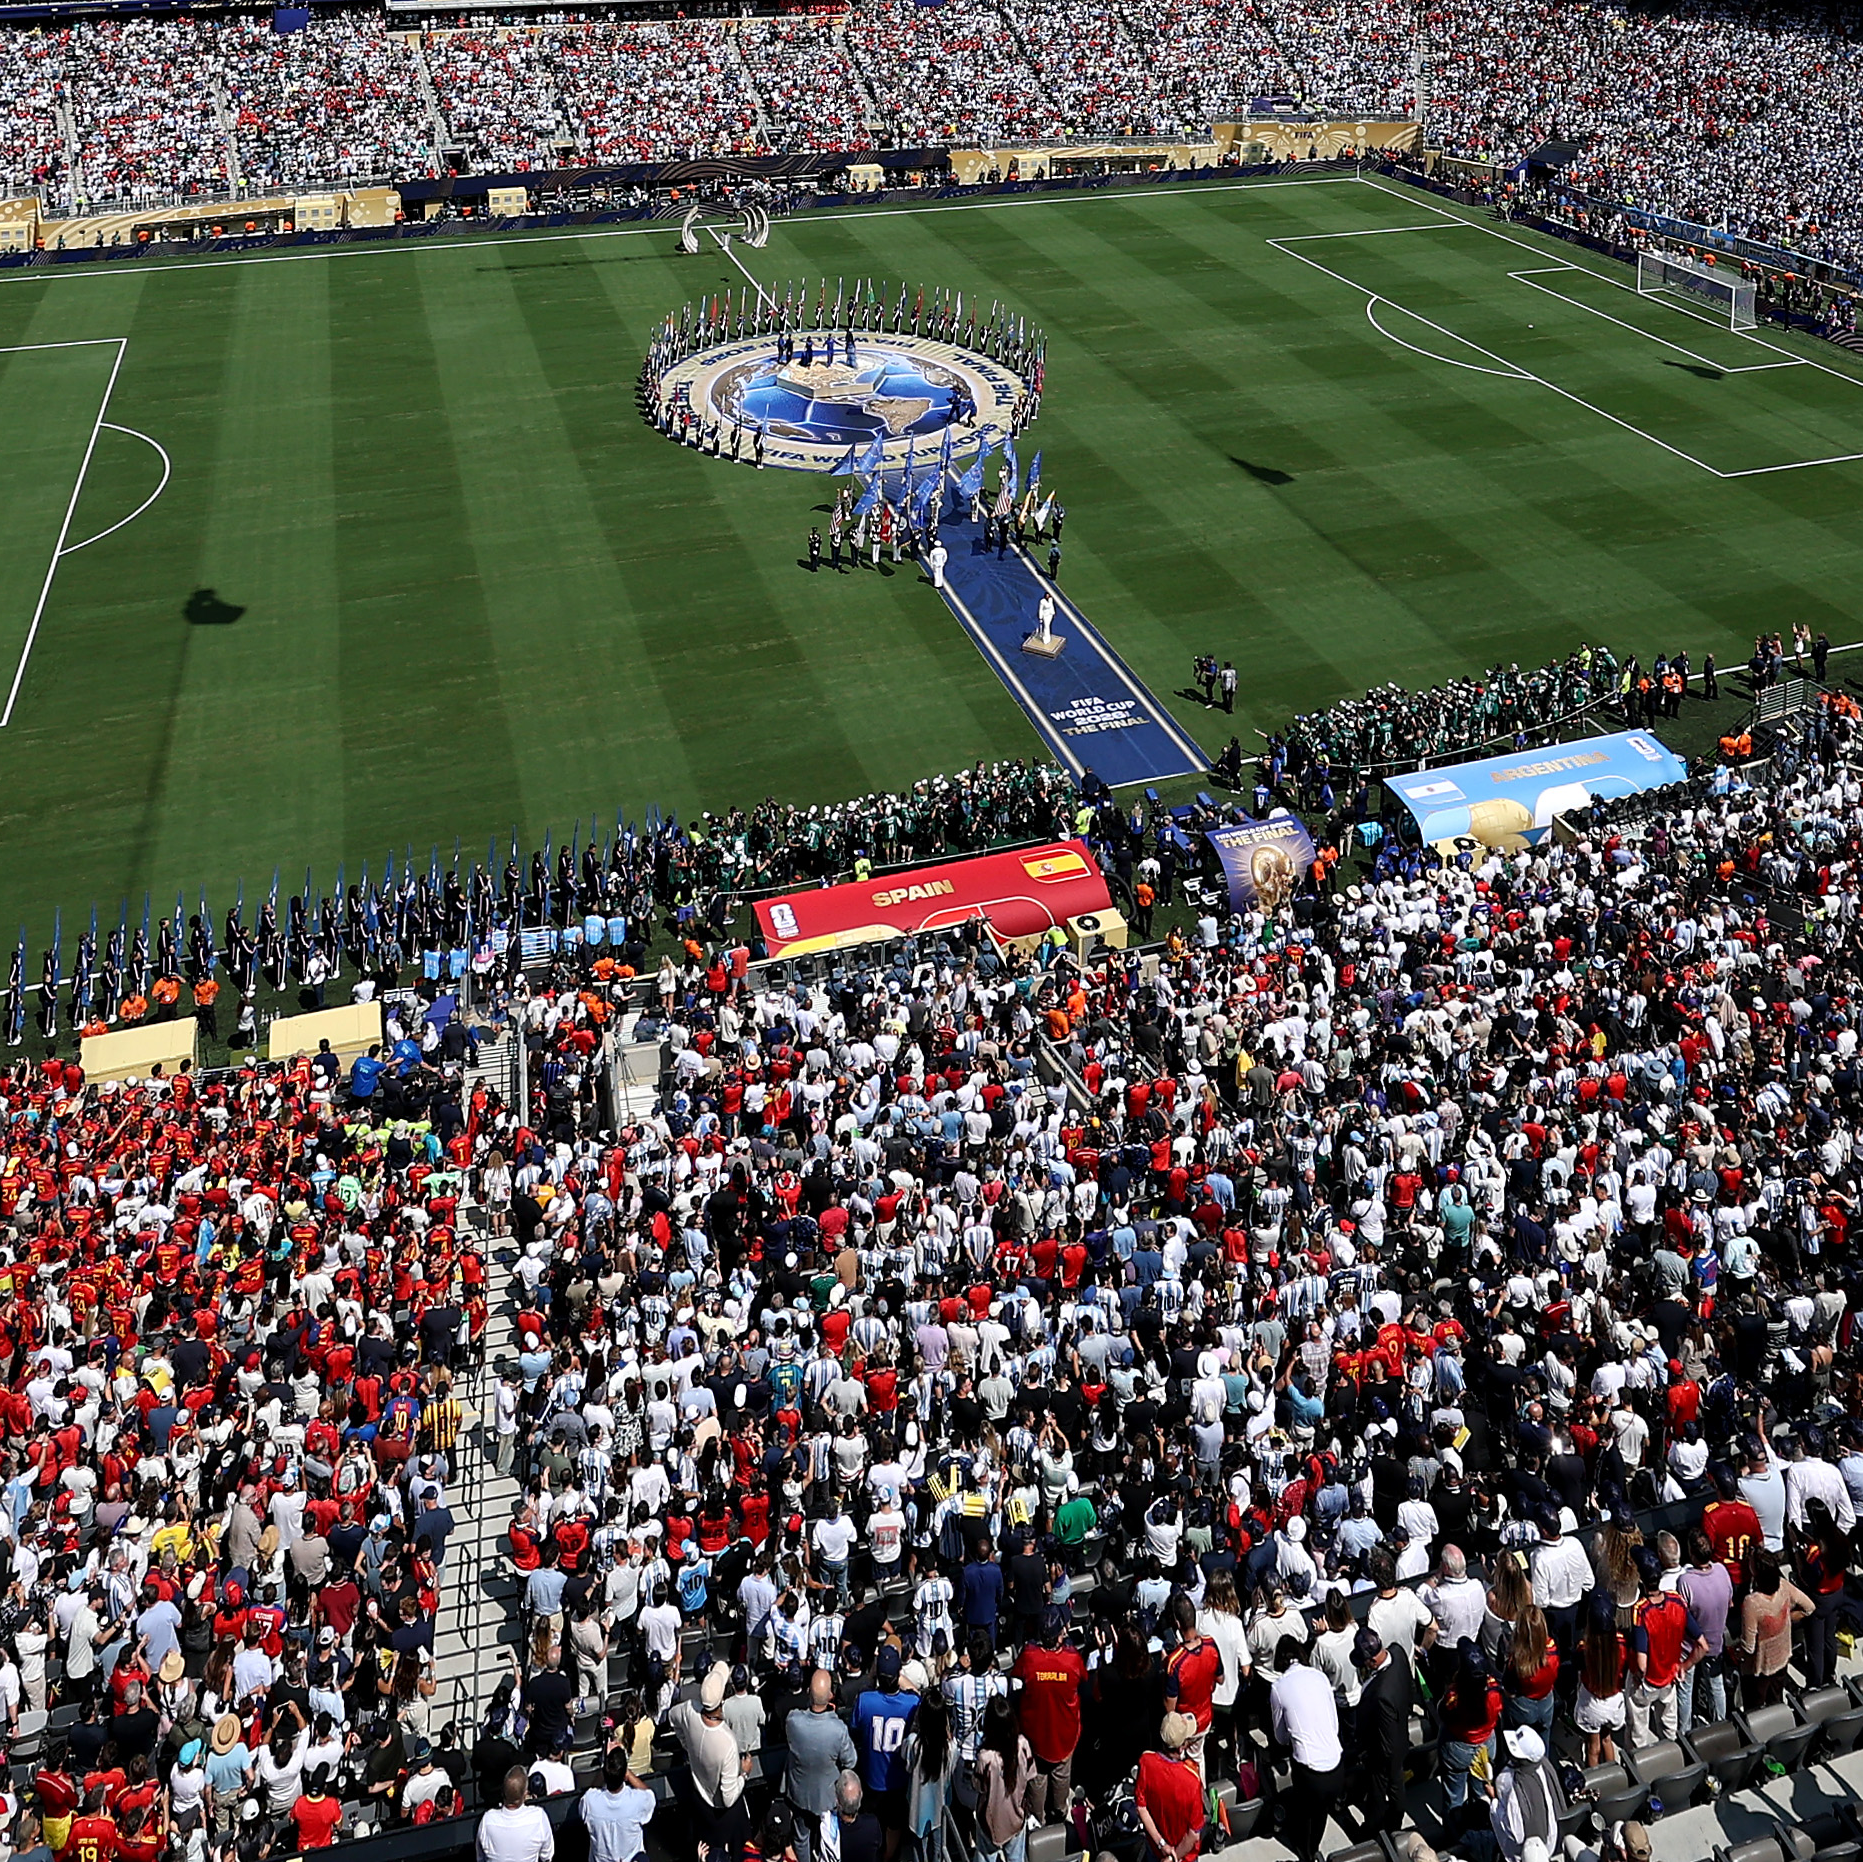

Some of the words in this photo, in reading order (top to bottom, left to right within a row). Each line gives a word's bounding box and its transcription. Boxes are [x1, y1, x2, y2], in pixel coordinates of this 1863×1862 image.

[1295, 131, 1313, 139] FIFA
[953, 353, 1005, 382] FINAL
[991, 383, 1014, 406] THE
[813, 454, 896, 463] WOD
[1050, 705, 1106, 721] WORLD
[1108, 700, 1136, 712] CUP
[1070, 696, 1105, 709] FIFA
[1062, 724, 1099, 736] THE
[1099, 716, 1150, 731] FINAL
[1074, 710, 1127, 726] 2026
[1490, 750, 1612, 784] ARGENTINA
[1219, 833, 1254, 849] THE
[1253, 826, 1301, 843] FINAL
[871, 879, 955, 907] SPAIN
[1003, 1256, 1020, 1272] 17
[873, 1716, 906, 1751] 10
